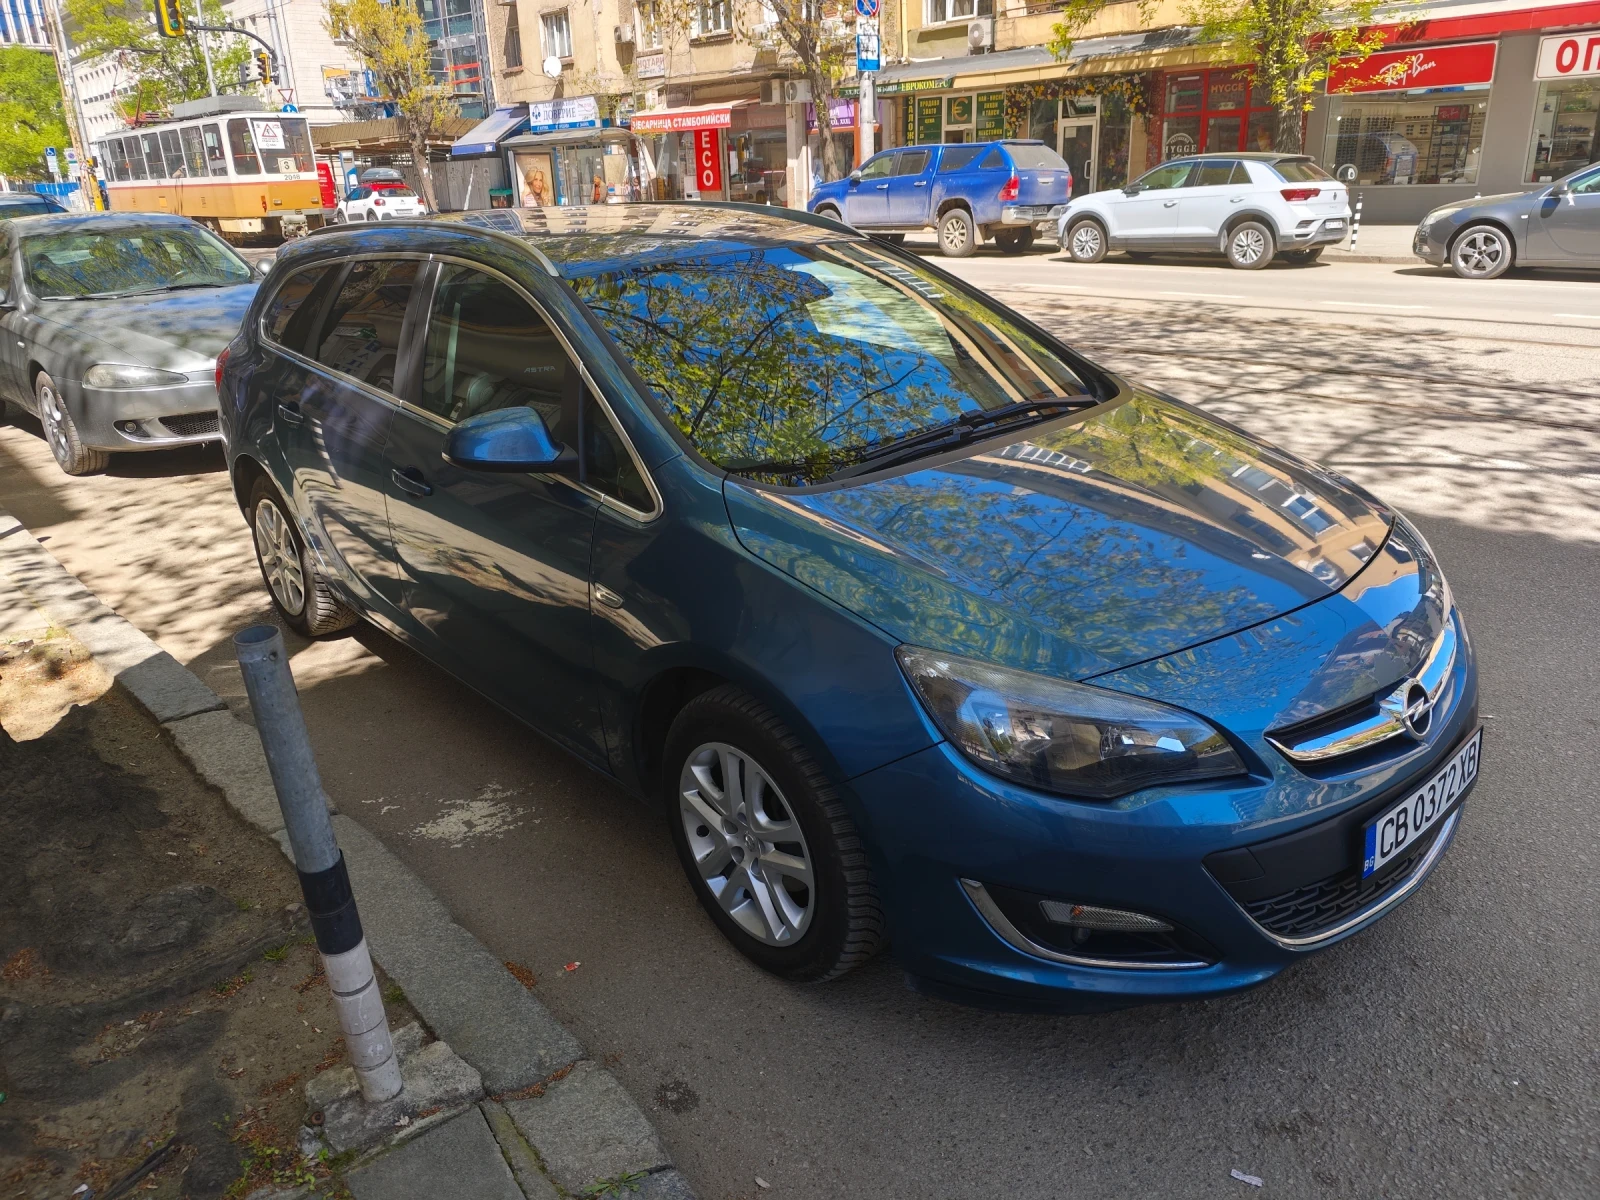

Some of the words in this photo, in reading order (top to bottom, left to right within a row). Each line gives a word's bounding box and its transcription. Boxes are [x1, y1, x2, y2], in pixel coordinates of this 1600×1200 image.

[901, 79, 949, 92] ЕВРОКОМЕРС
[1210, 82, 1245, 94] HYGGE
[543, 107, 576, 121] ДОВЕРИЕ
[673, 113, 730, 127] СТАМБОЛИЙСКИ
[1164, 144, 1197, 153] HYGGE
[523, 365, 556, 374] ASTRA
[1380, 806, 1409, 859] CB
[1413, 763, 1457, 832] 0372
[1458, 740, 1477, 790] XB
[1364, 855, 1375, 872] BG
